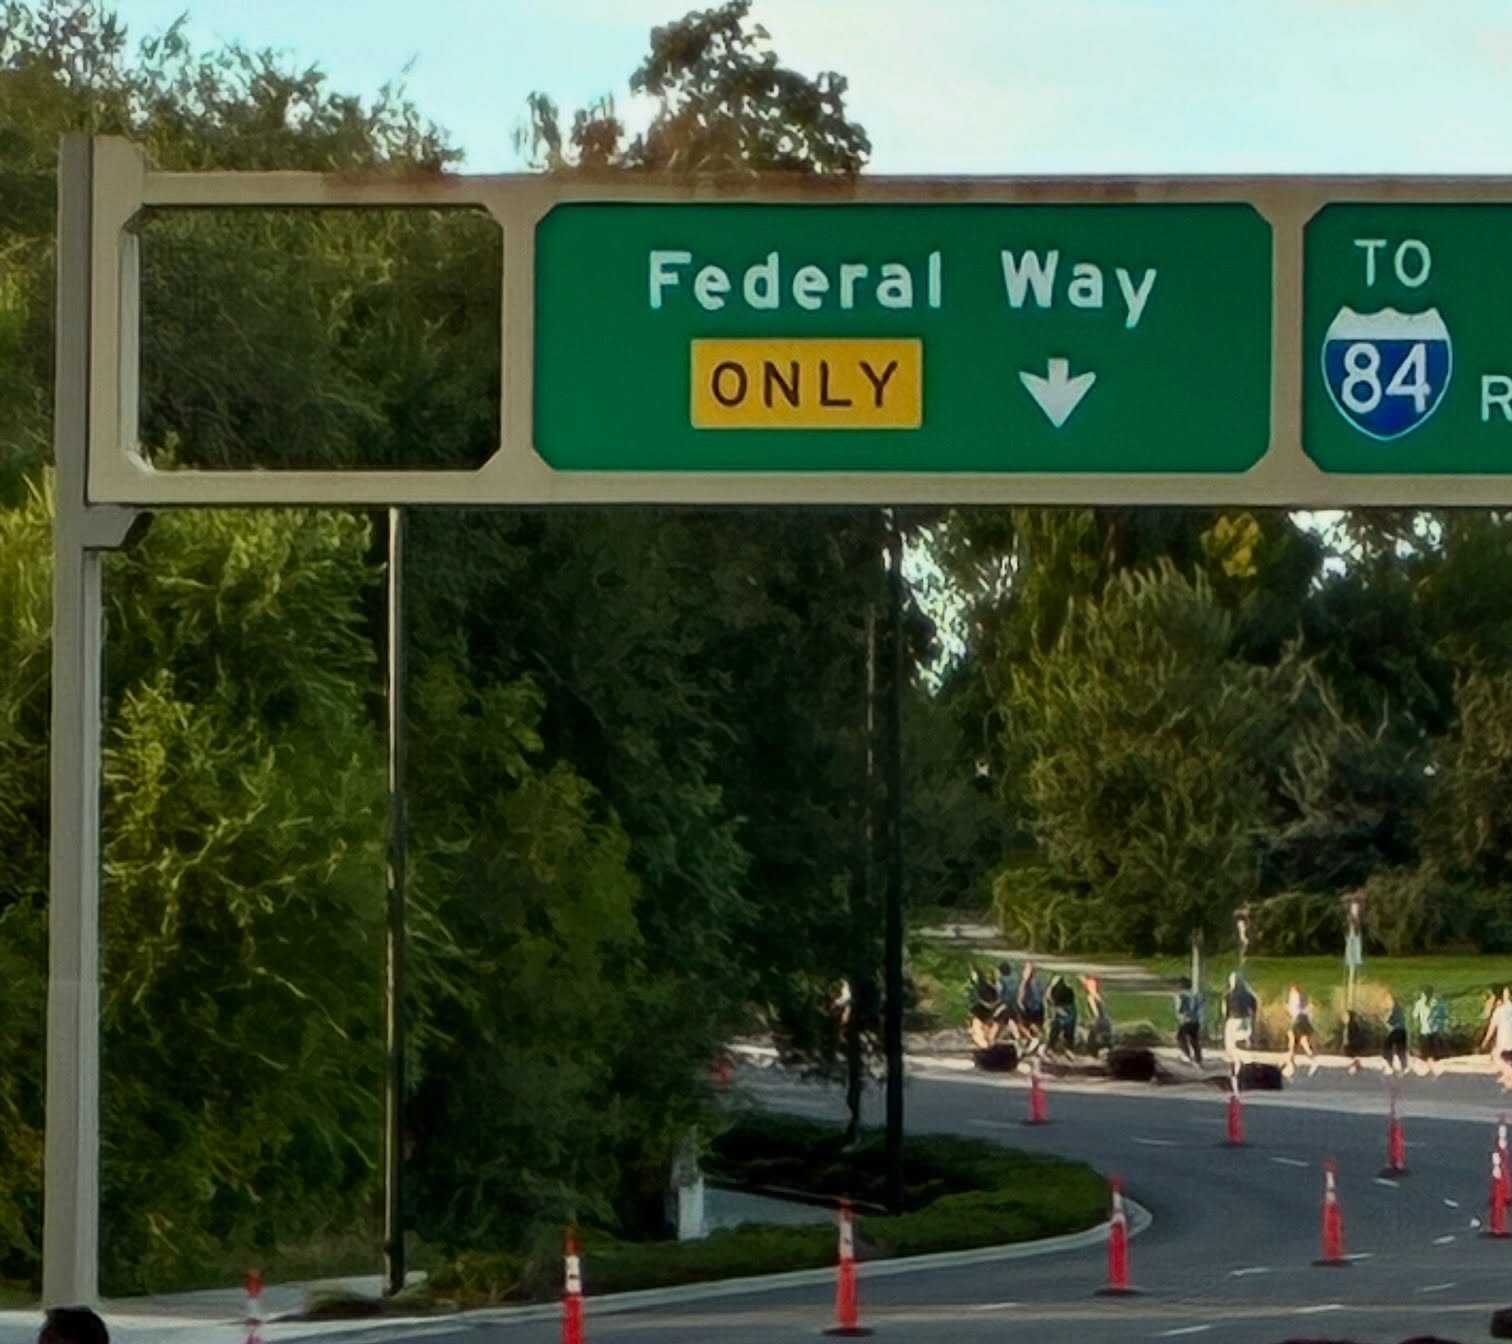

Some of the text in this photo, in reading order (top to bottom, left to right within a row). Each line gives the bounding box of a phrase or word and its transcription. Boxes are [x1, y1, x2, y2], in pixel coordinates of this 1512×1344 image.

[649, 249, 1158, 328] Federal Way
[1354, 239, 1432, 287] TO
[711, 360, 898, 409] ONLY
[1340, 342, 1432, 416] 84
